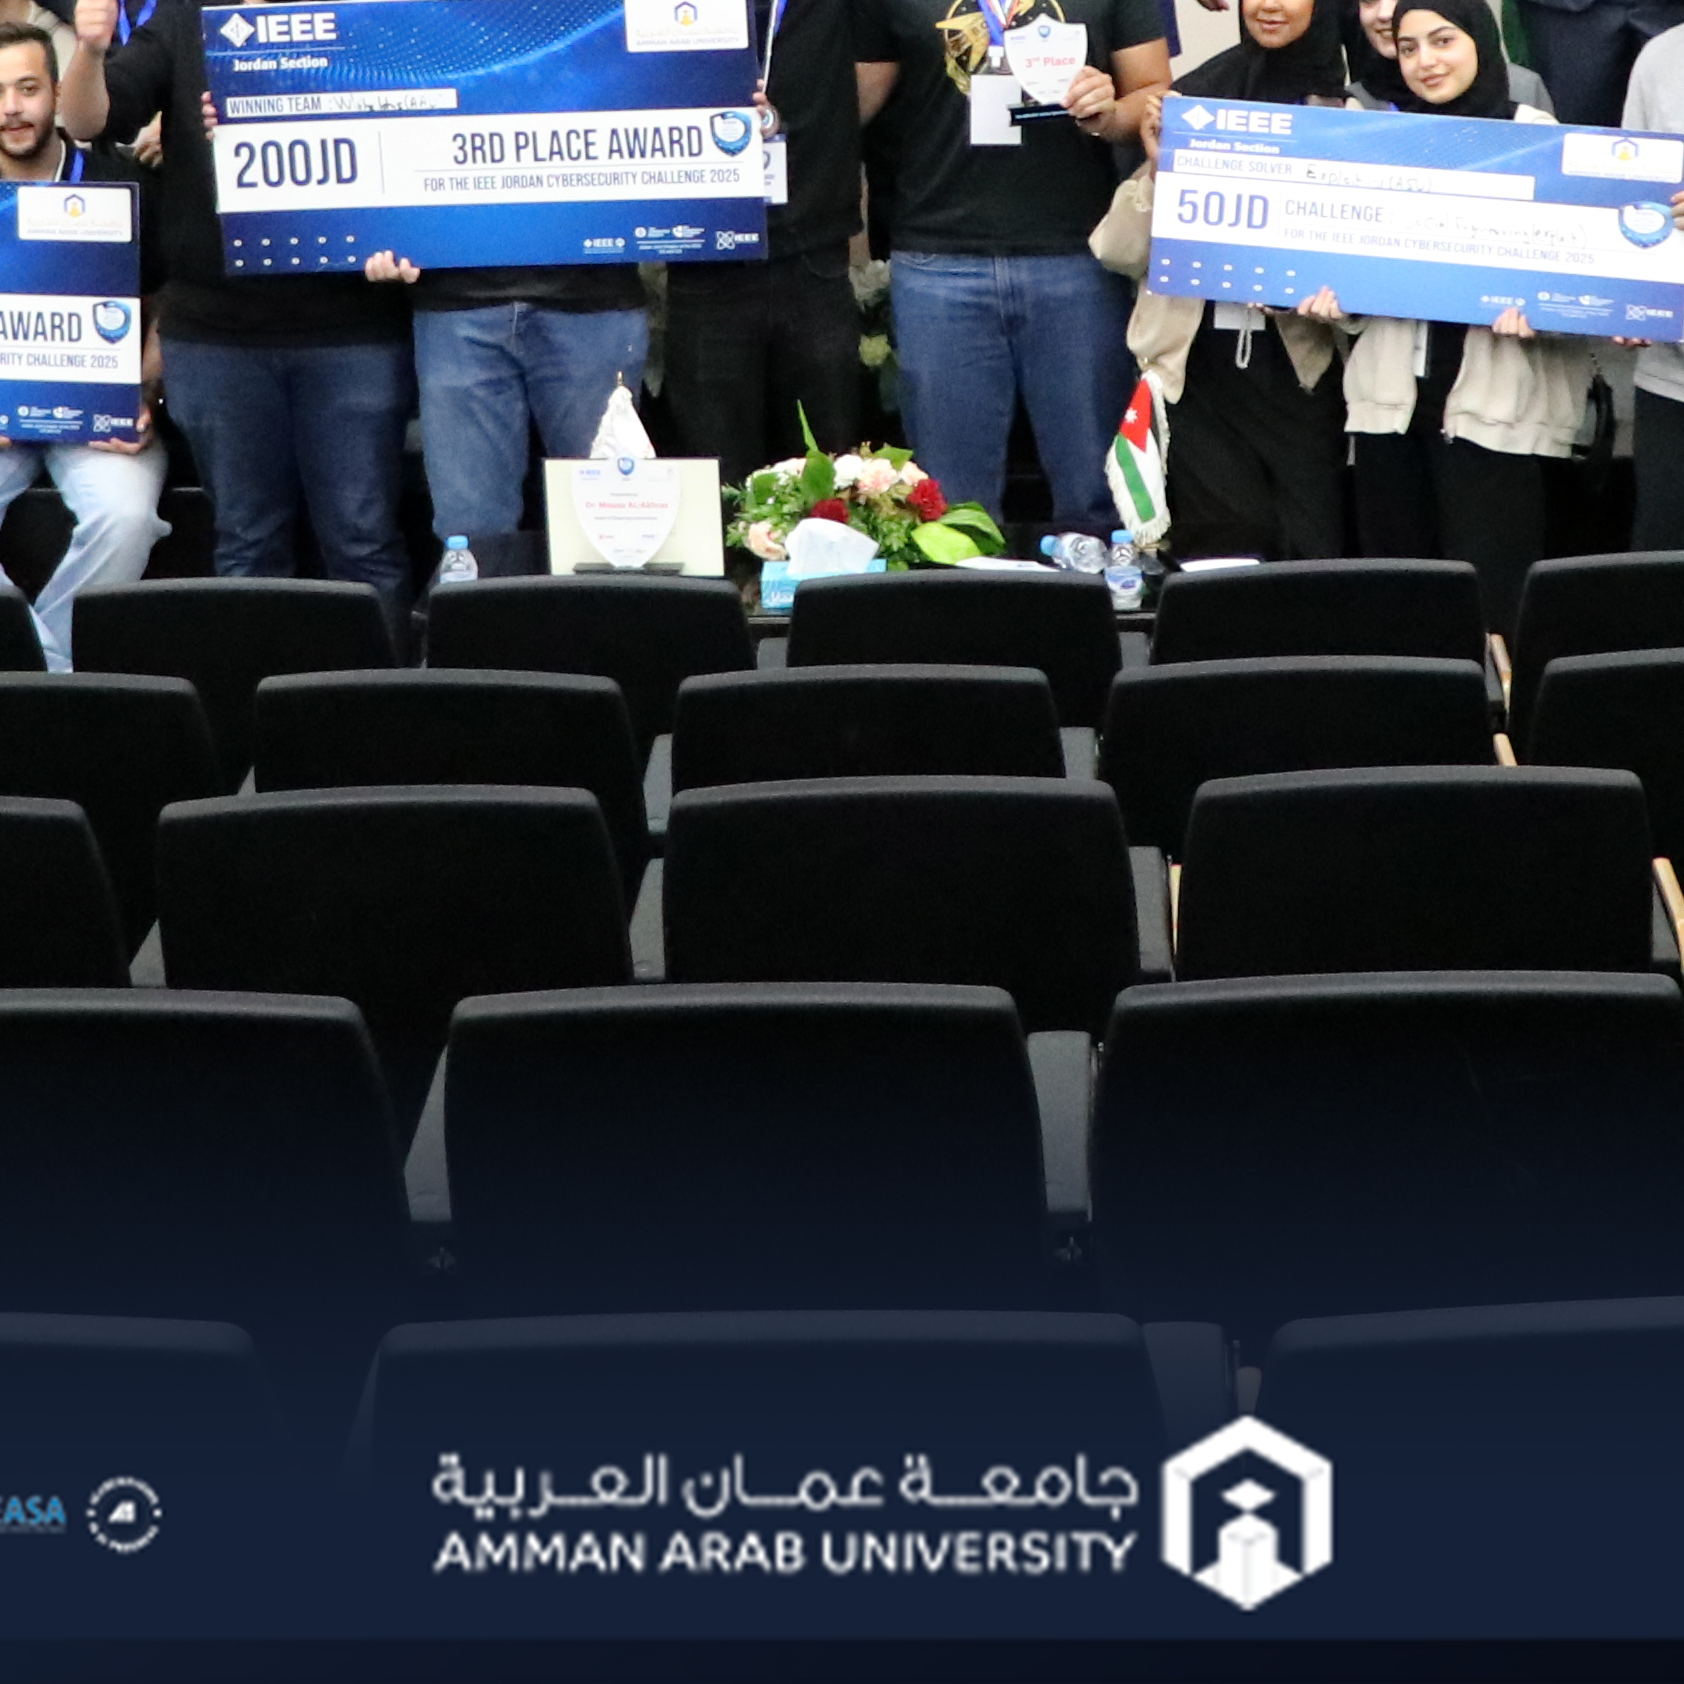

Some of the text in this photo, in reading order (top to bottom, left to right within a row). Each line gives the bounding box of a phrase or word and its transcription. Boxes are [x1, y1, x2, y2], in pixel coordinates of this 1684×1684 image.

[256, 12, 337, 44] IEEE
[232, 54, 329, 73] Jordan Section
[1024, 53, 1076, 68] 3rd Place
[229, 98, 285, 115] WINNING
[288, 96, 322, 113] TEAM
[1217, 108, 1293, 135] IEEE
[233, 124, 704, 190] 200JD 3RD PLACE AWARD
[1189, 138, 1280, 155] Jordan Section
[1176, 154, 1293, 175] CHALLENGE SOLVER
[423, 168, 741, 192] FOR THE IEEE JORDAN CYBERSECURITY CHALLENGE 2025
[1176, 189, 1384, 230] 50JD CHALLENGE
[1283, 228, 1596, 266] FOR THE IEEE JORDAN CYBERSECURITY CHALLENGE 2025
[26, 351, 87, 369] CHALLENGE
[90, 353, 119, 369] 2025
